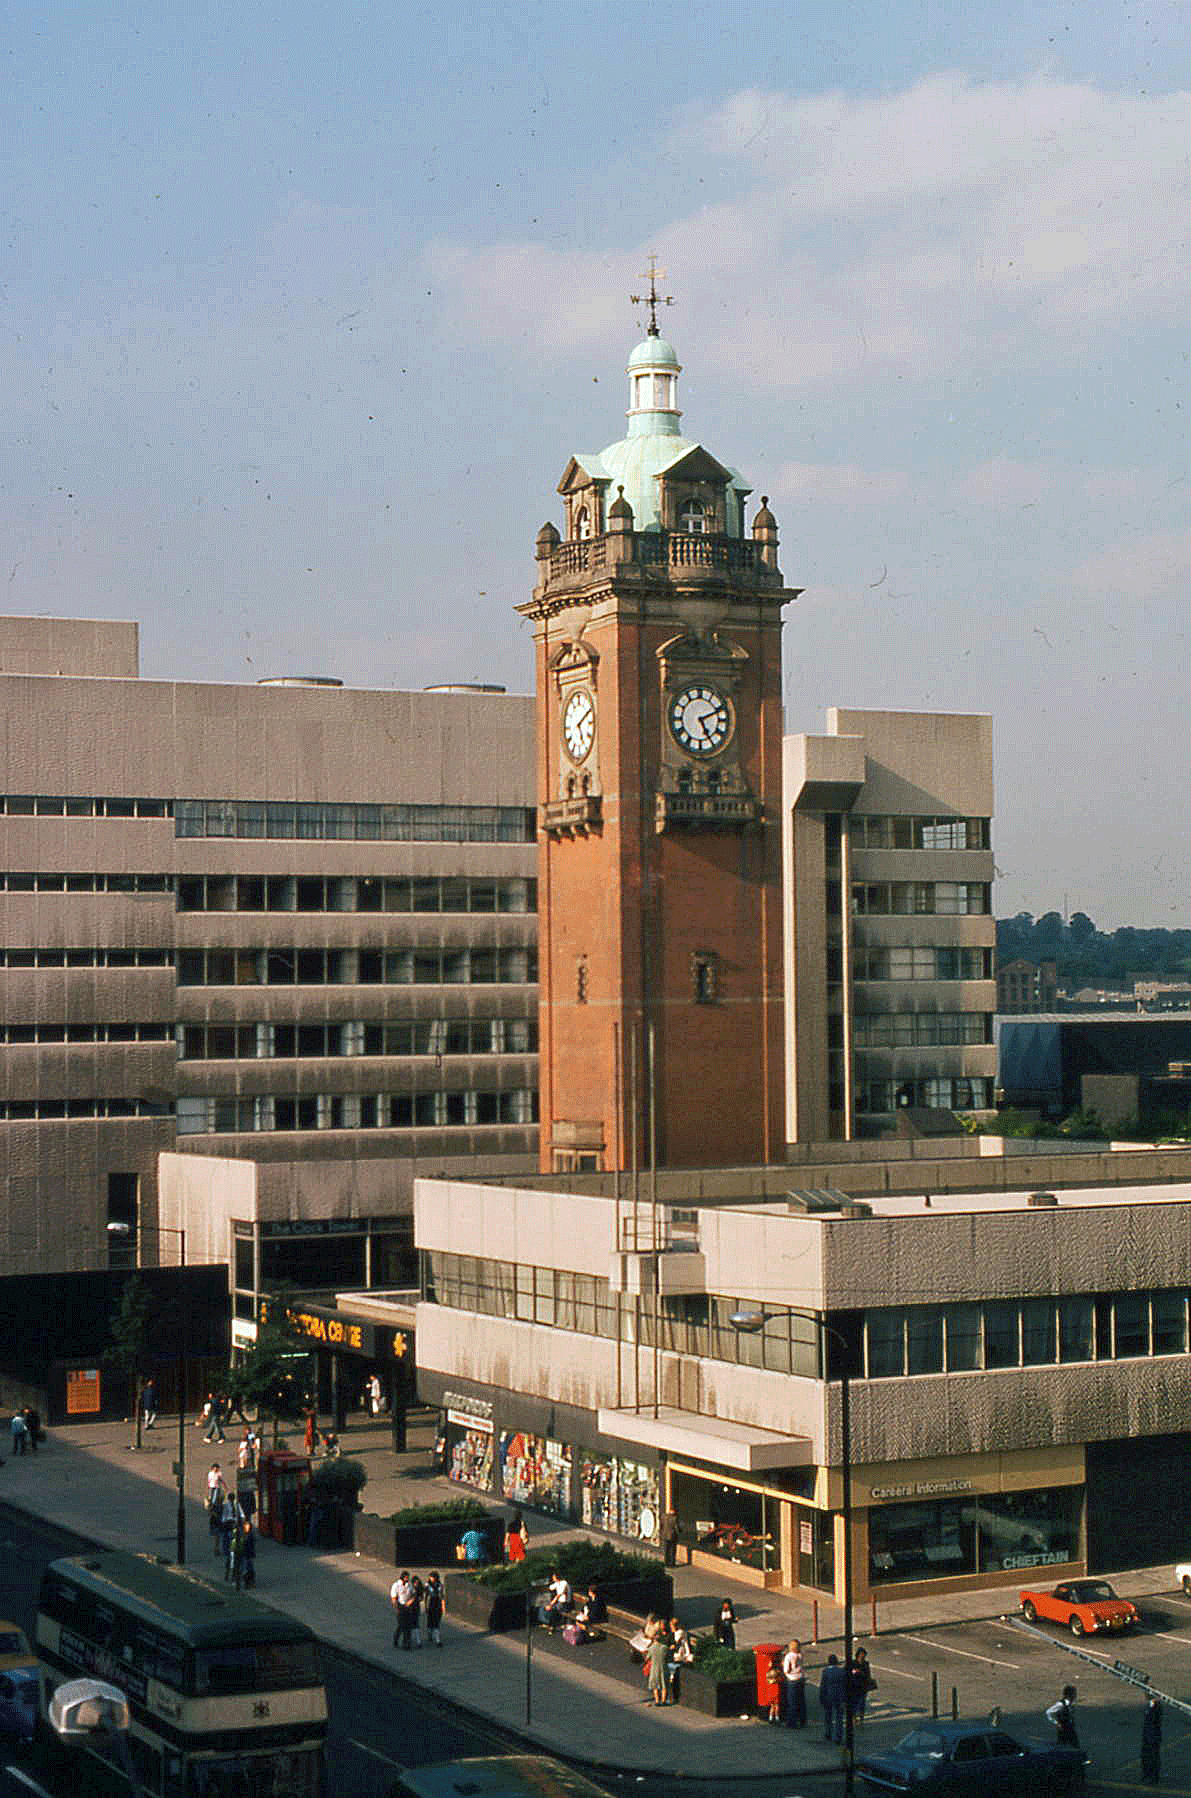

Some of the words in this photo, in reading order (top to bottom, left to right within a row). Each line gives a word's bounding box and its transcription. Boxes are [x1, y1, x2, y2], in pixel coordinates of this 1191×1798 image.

[871, 1487, 913, 1498] Careers
[916, 1479, 972, 1494] Information
[1002, 1550, 1069, 1569] CHIEFTAIN
